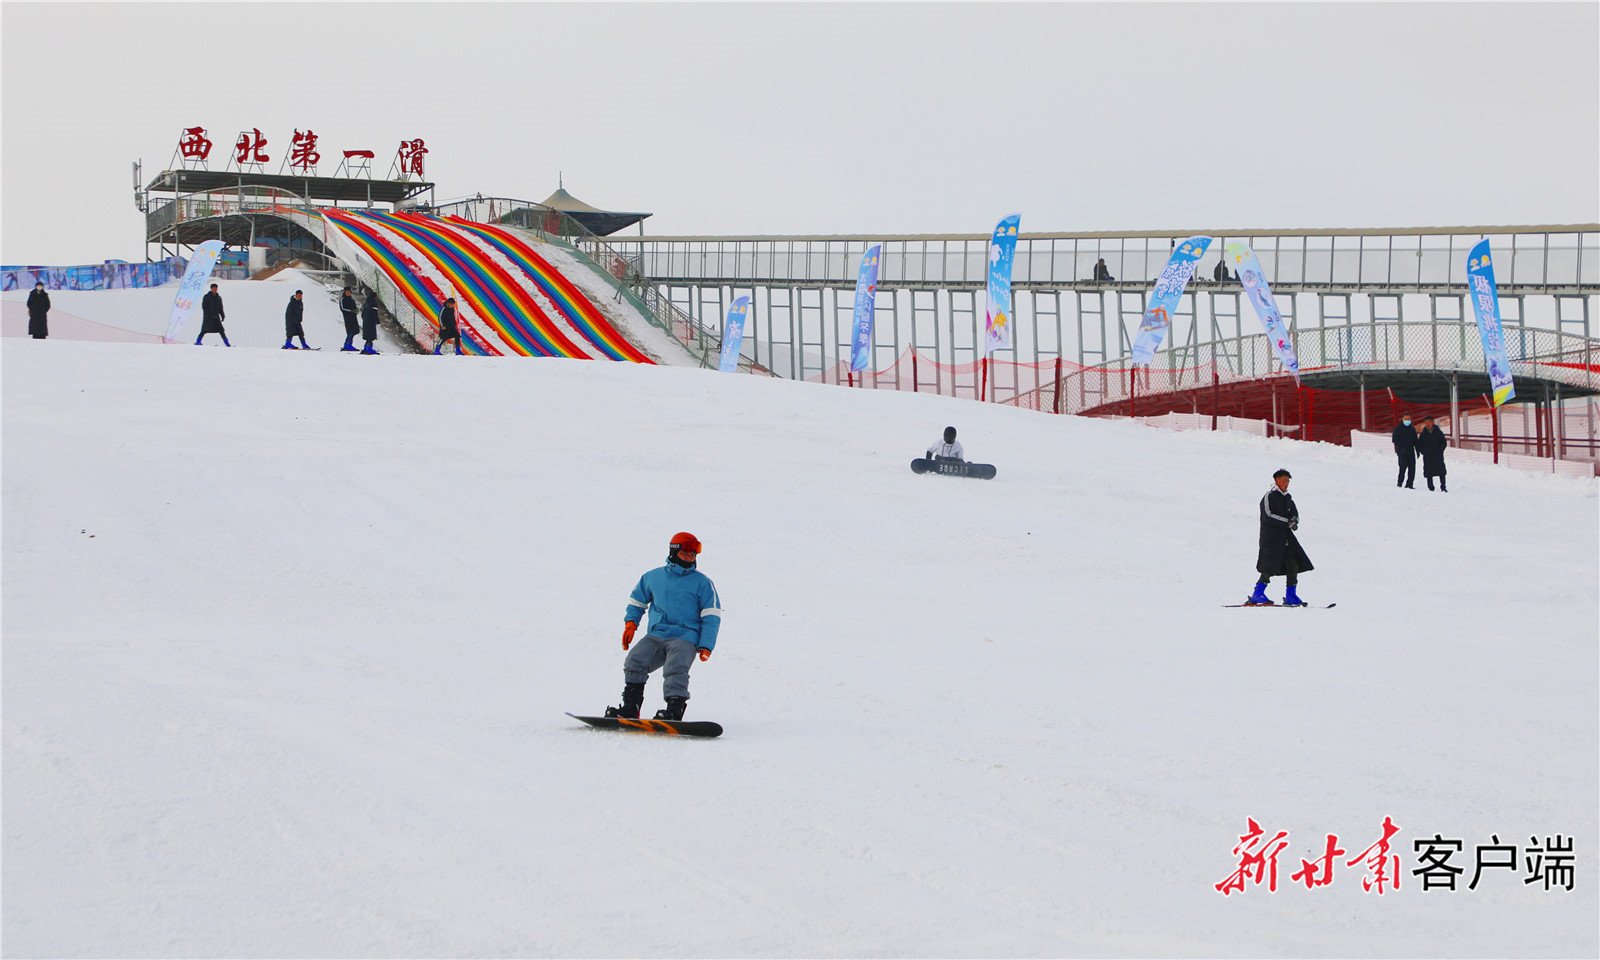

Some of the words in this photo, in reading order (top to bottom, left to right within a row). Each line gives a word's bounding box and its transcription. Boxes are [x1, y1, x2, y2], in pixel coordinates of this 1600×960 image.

[180, 126, 429, 177] 西北第一滑
